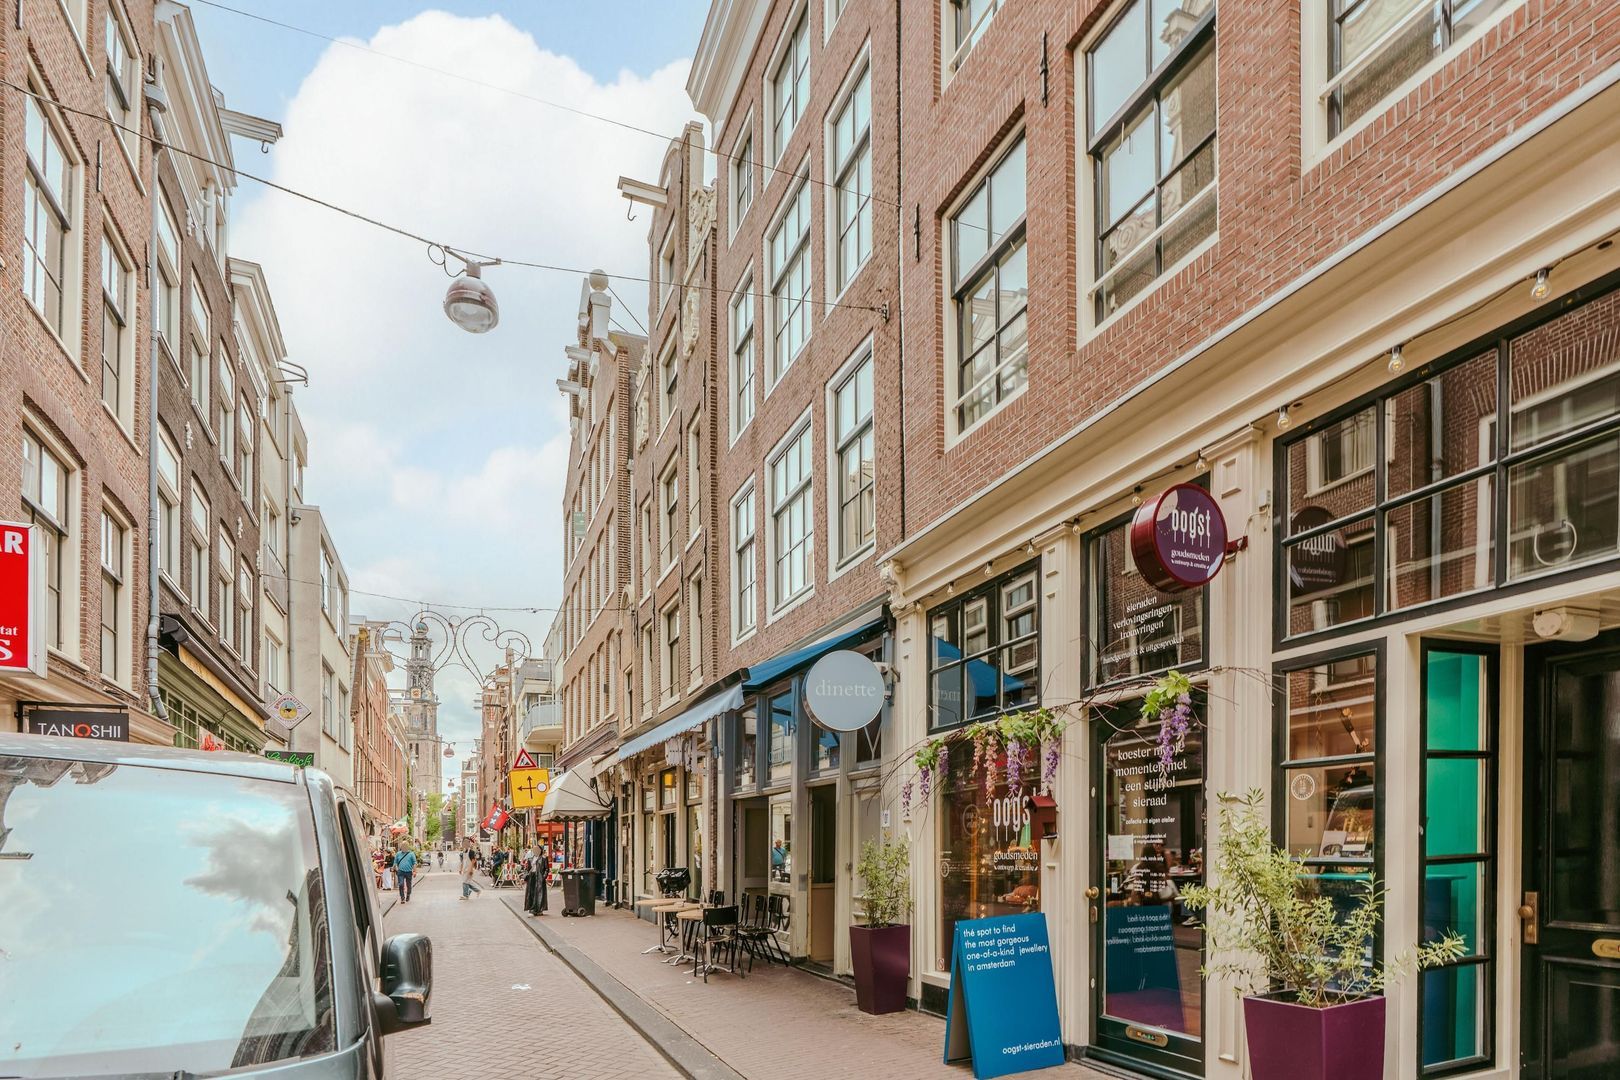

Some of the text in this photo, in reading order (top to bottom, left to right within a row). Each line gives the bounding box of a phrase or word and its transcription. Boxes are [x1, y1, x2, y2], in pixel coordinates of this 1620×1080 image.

[1172, 506, 1210, 546] oogst
[0, 530, 24, 554] R
[1171, 550, 1210, 561] goudsmeden
[1126, 596, 1157, 613] sieraden
[1113, 604, 1172, 630] verlovingsringen
[1120, 620, 1164, 640] trouwringen
[815, 680, 877, 697] dinette
[38, 722, 120, 738] TANOSHII
[1118, 748, 1151, 761] koester
[1168, 758, 1187, 771] met
[1125, 782, 1141, 791] een
[1133, 794, 1167, 807] sieraad
[994, 787, 1037, 838] oogs
[994, 850, 1038, 862] goudsmeden
[977, 927, 992, 938] spot
[994, 926, 1000, 934] to
[1002, 923, 1016, 933] find
[965, 935, 1029, 949] the most gorgeous
[966, 943, 1048, 960] one-of-a-kind jewellery
[968, 959, 1015, 972] in amsterdam
[1002, 1036, 1060, 1055] oogst-sieraden.nl
